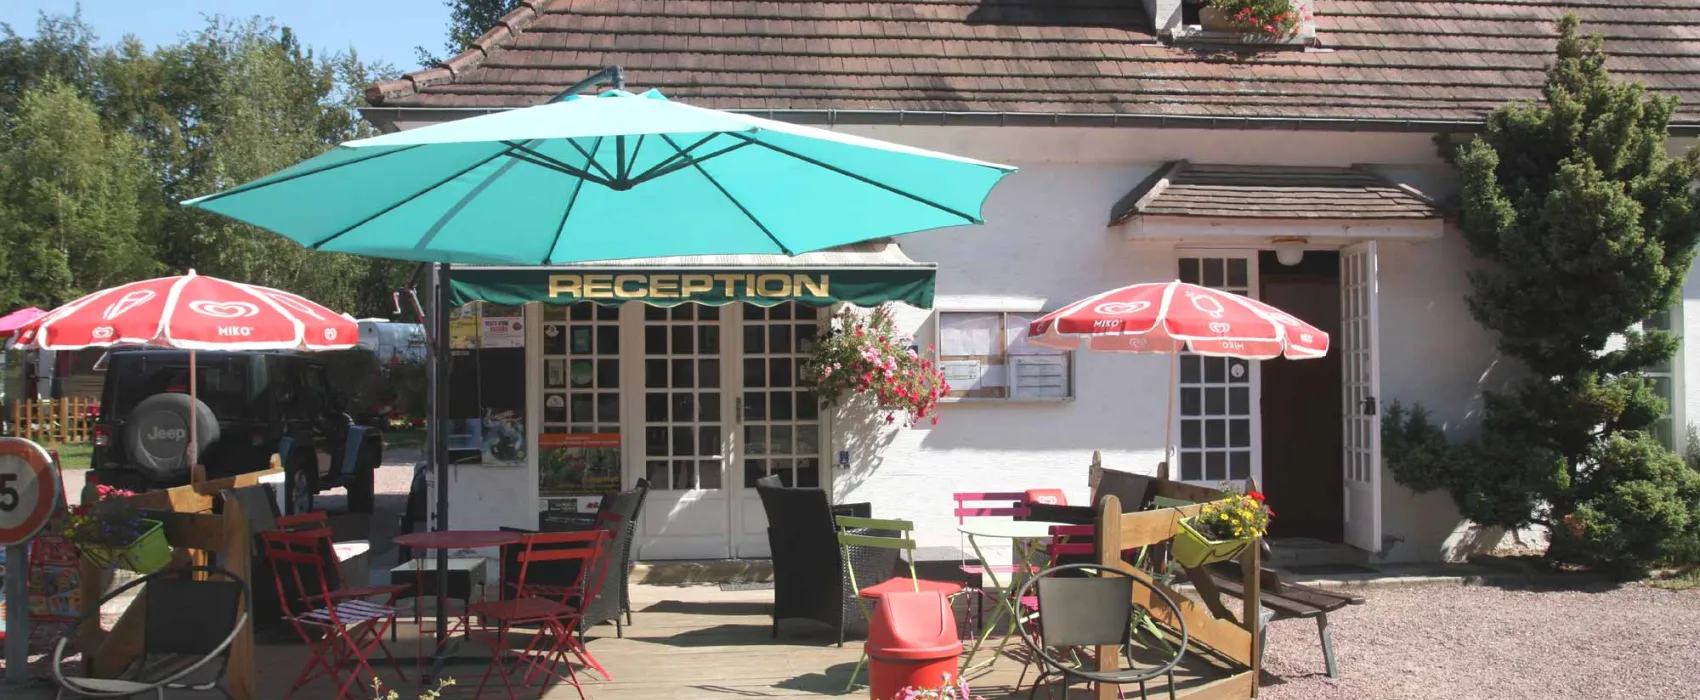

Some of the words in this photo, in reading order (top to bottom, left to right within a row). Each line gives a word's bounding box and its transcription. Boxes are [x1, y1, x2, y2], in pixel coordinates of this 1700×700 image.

[549, 274, 829, 298] RECEPTION
[218, 325, 251, 336] MIKO
[1094, 319, 1120, 328] MIKO
[147, 426, 186, 442] Jeep
[0, 473, 19, 512] 5
